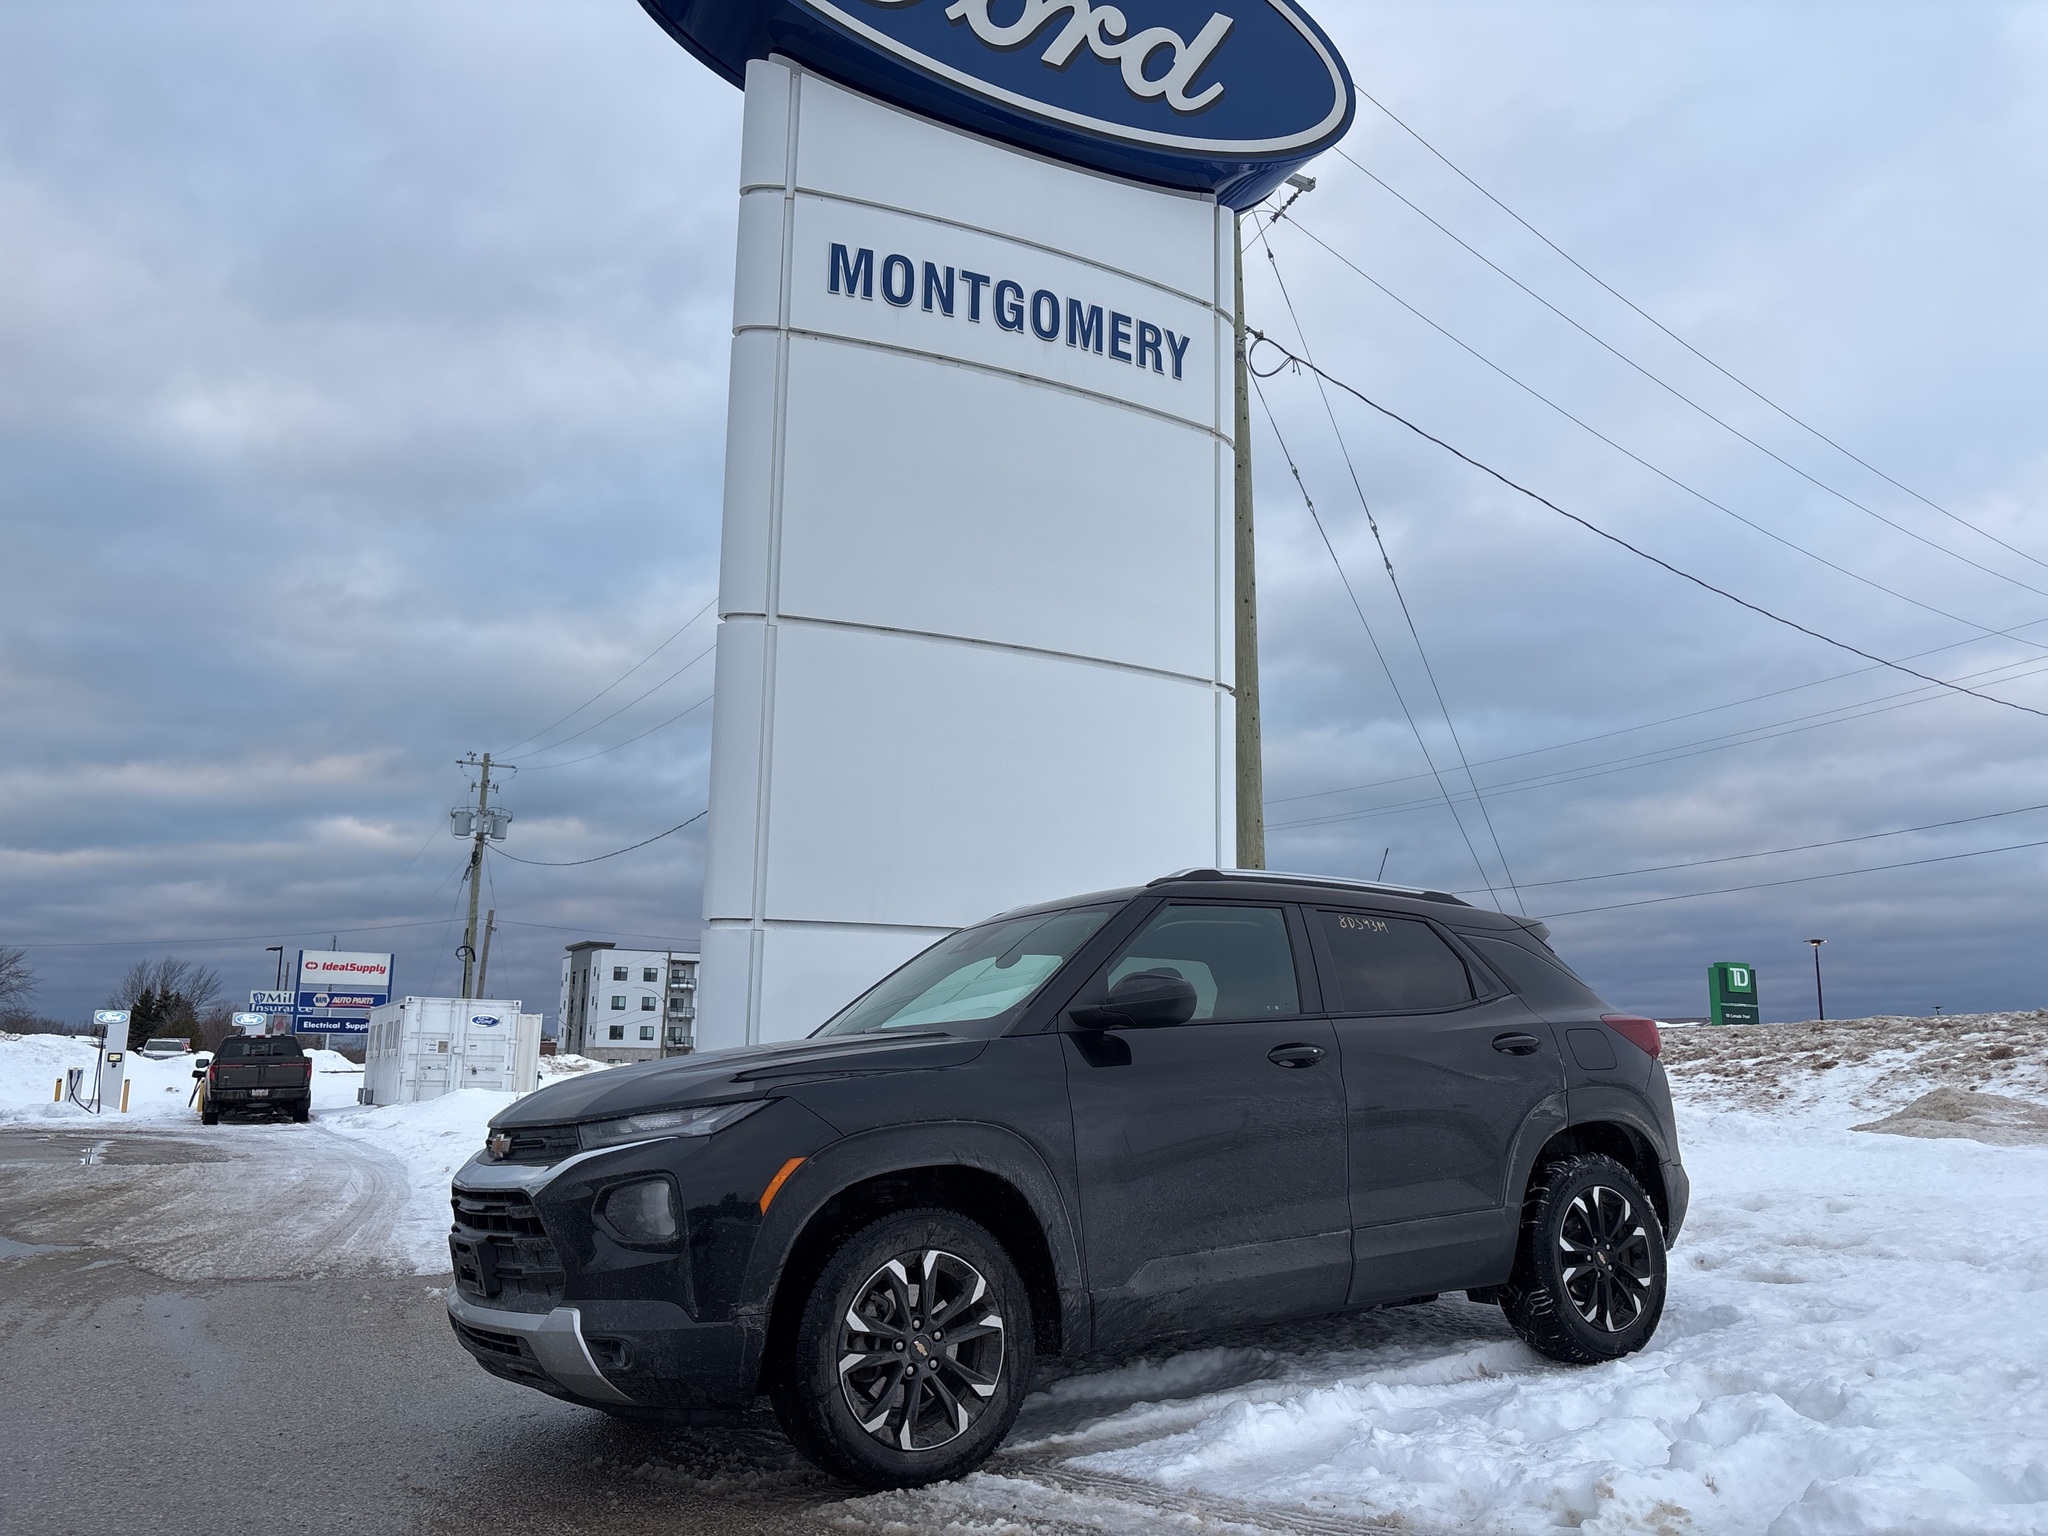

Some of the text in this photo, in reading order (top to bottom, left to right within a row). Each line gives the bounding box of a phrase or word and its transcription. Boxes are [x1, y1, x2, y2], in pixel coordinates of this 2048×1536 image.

[861, 0, 1235, 113] ord
[828, 241, 1191, 380] MONTGOMERY
[321, 962, 387, 974] IdealSupply
[1729, 967, 1749, 987] TD
[331, 996, 352, 1004] AUTO
[352, 997, 375, 1005] PARTS
[303, 1021, 341, 1029] Electrical
[475, 1016, 493, 1024] Ford
